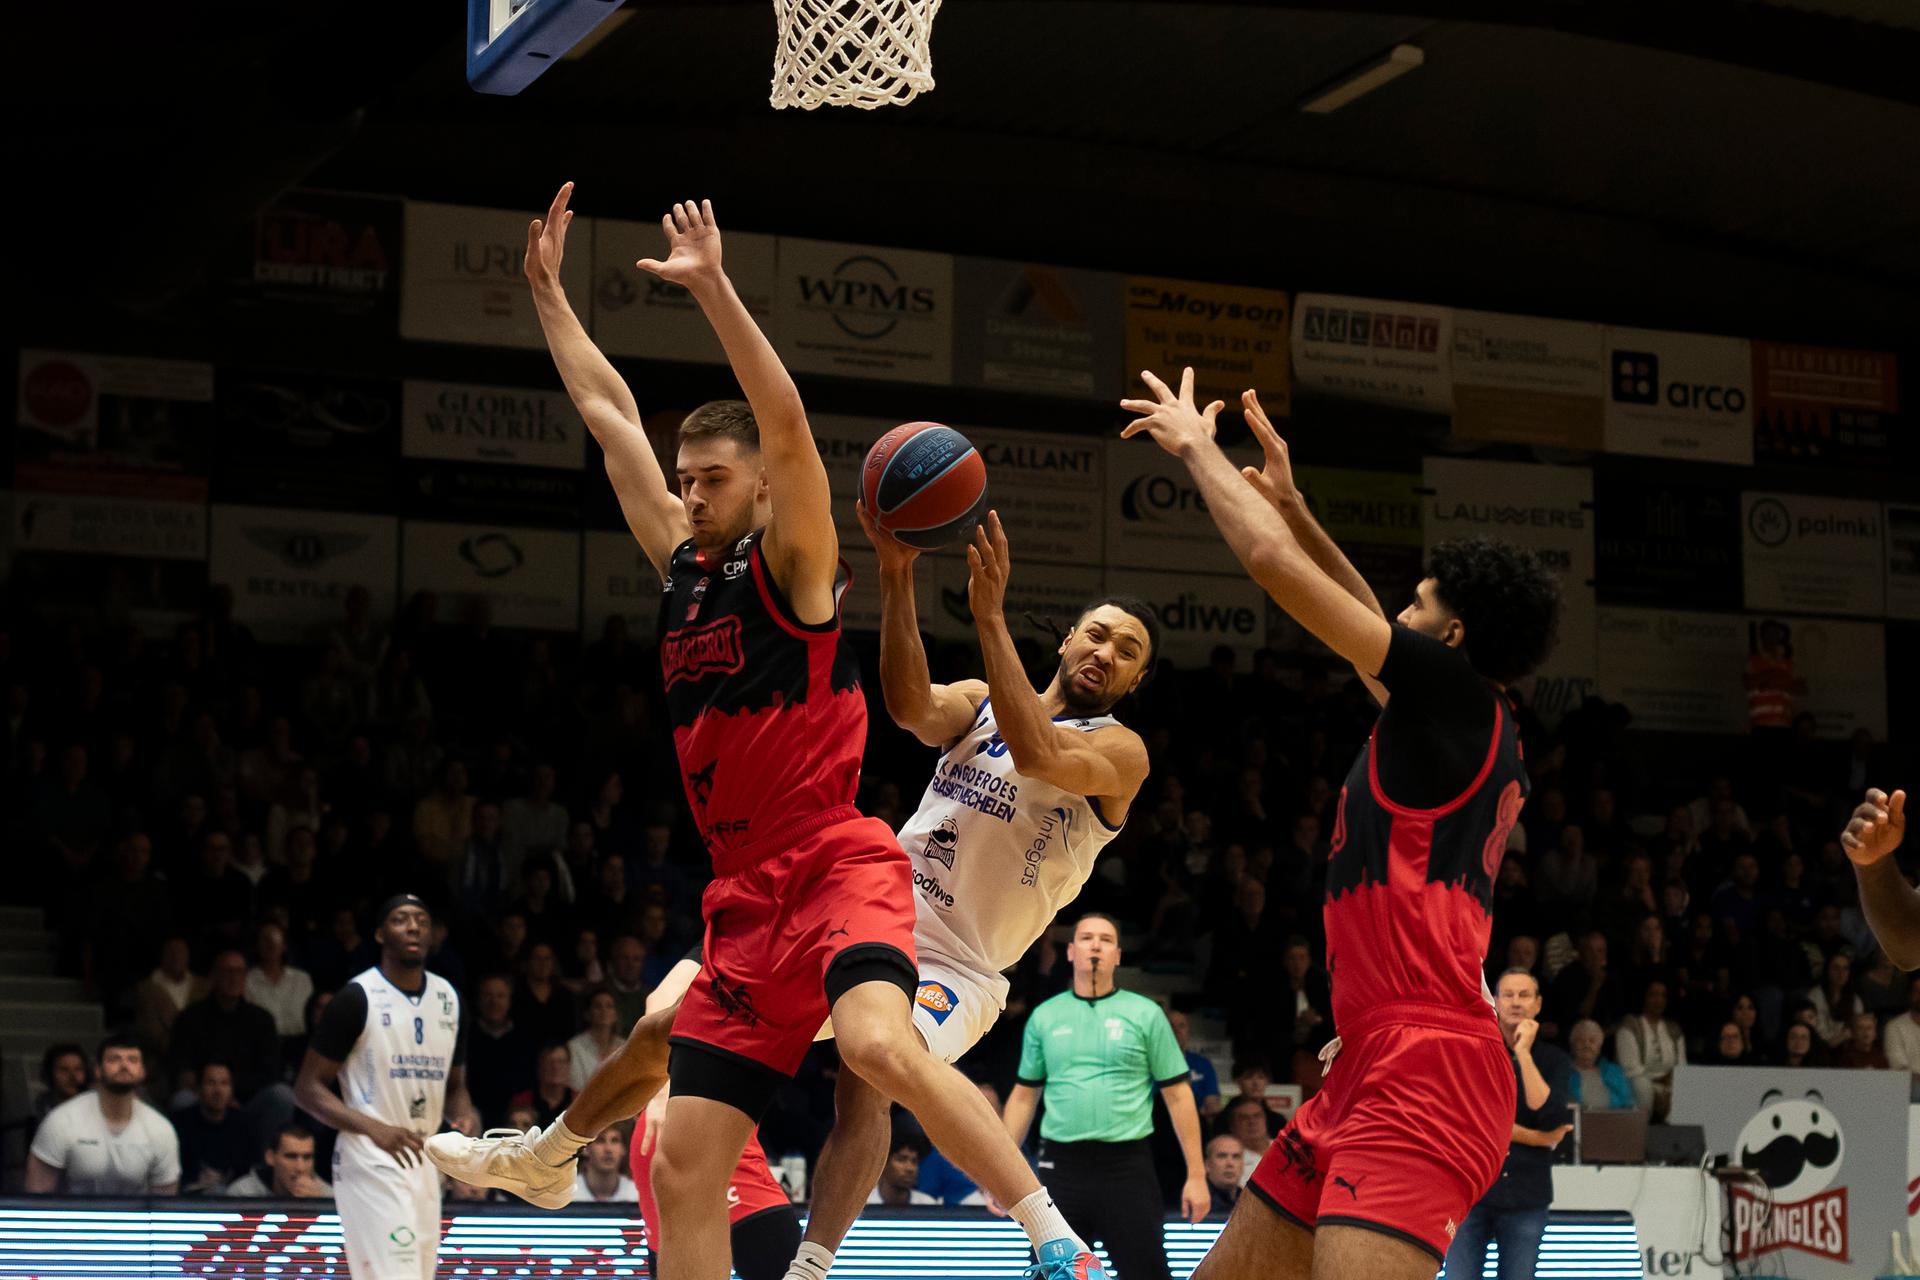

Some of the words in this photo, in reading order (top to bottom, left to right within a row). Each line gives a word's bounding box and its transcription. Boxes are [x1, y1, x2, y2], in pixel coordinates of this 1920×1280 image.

[454, 242, 527, 276] IURI
[797, 274, 935, 313] WPMS
[1158, 291, 1285, 323] Moyson
[438, 391, 546, 420] GLOBAL
[1667, 382, 1747, 413] arco
[425, 414, 567, 443] WINERIES
[983, 444, 1093, 473] CALLANT
[1434, 502, 1585, 529] LAUWERS
[1798, 514, 1877, 539] palmki
[938, 760, 1018, 803] KANGOEROES
[1021, 815, 1058, 887] Integras
[414, 1016, 424, 1045] 8
